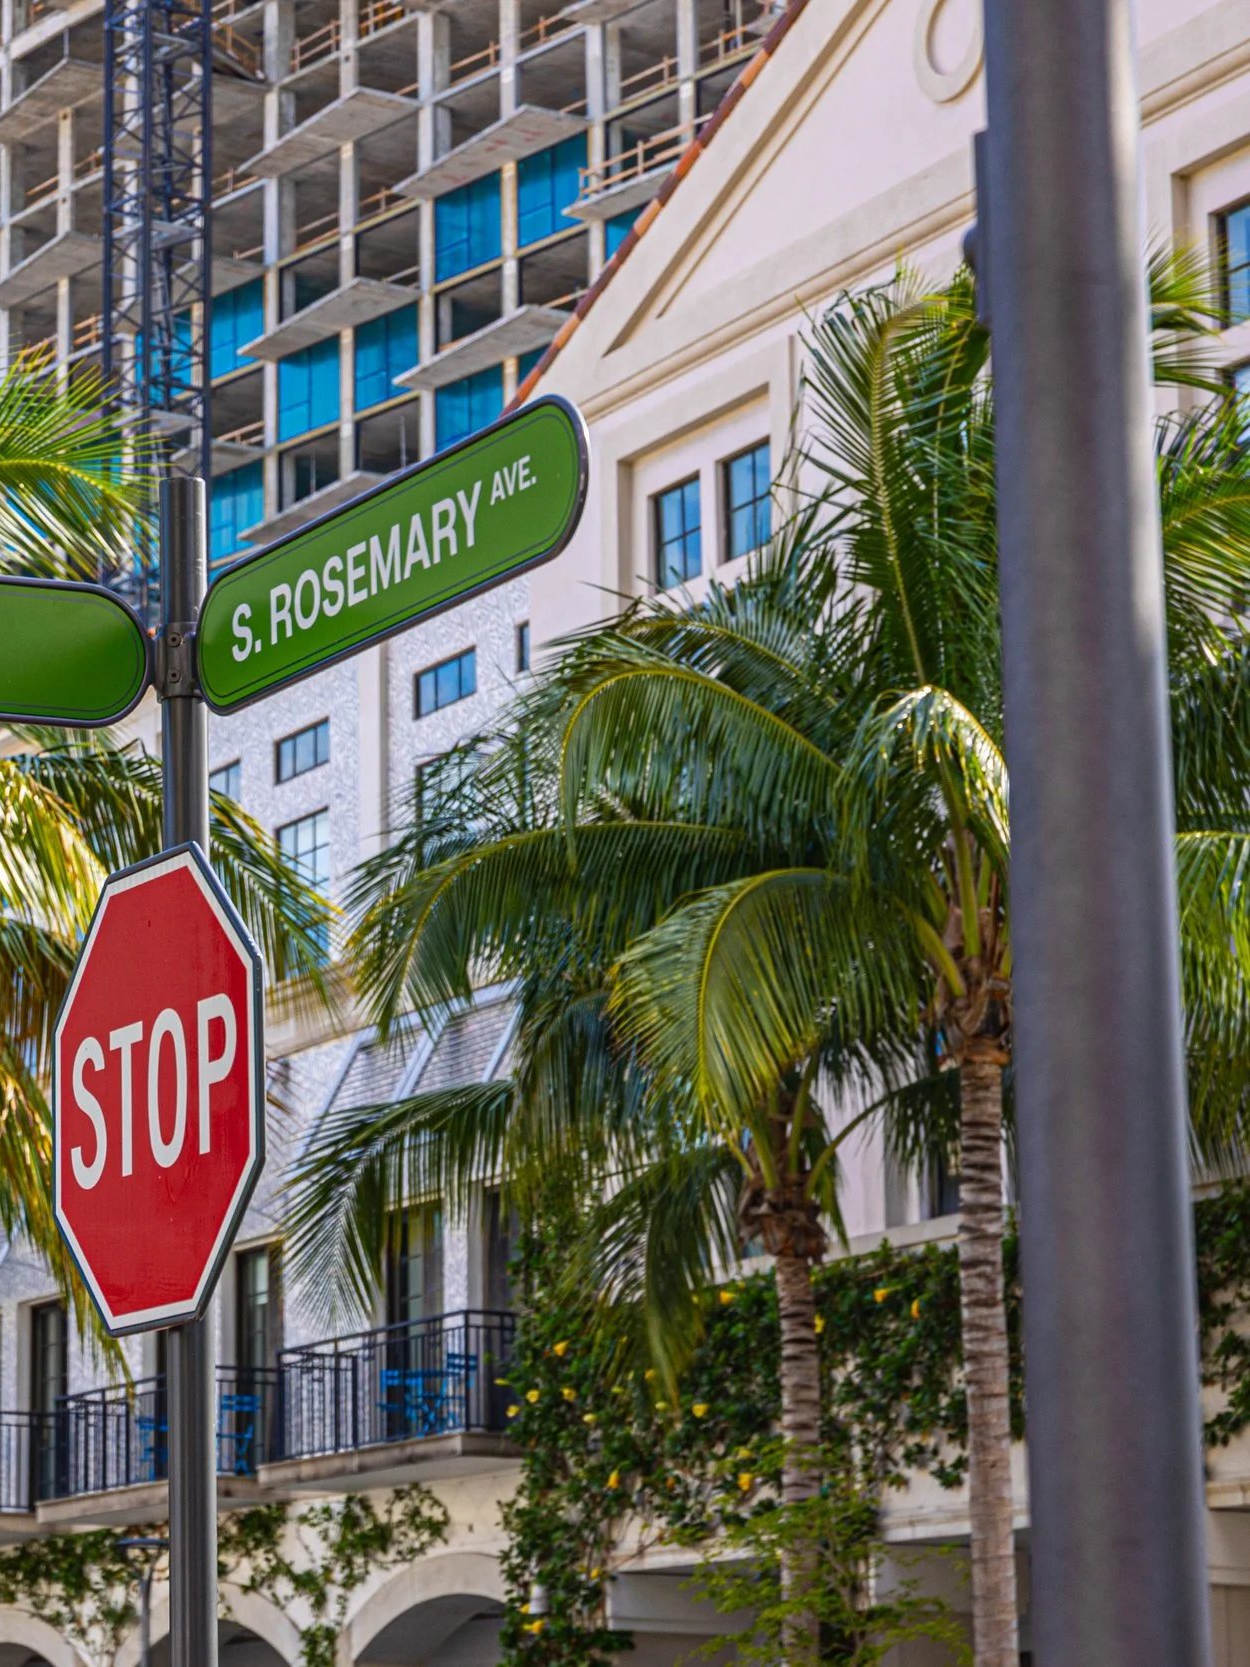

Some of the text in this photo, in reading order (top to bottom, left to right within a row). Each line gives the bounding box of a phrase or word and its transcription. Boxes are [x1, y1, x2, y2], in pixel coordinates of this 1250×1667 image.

[231, 455, 537, 663] S. ROSEMARY AVE.
[71, 993, 237, 1190] STOP
